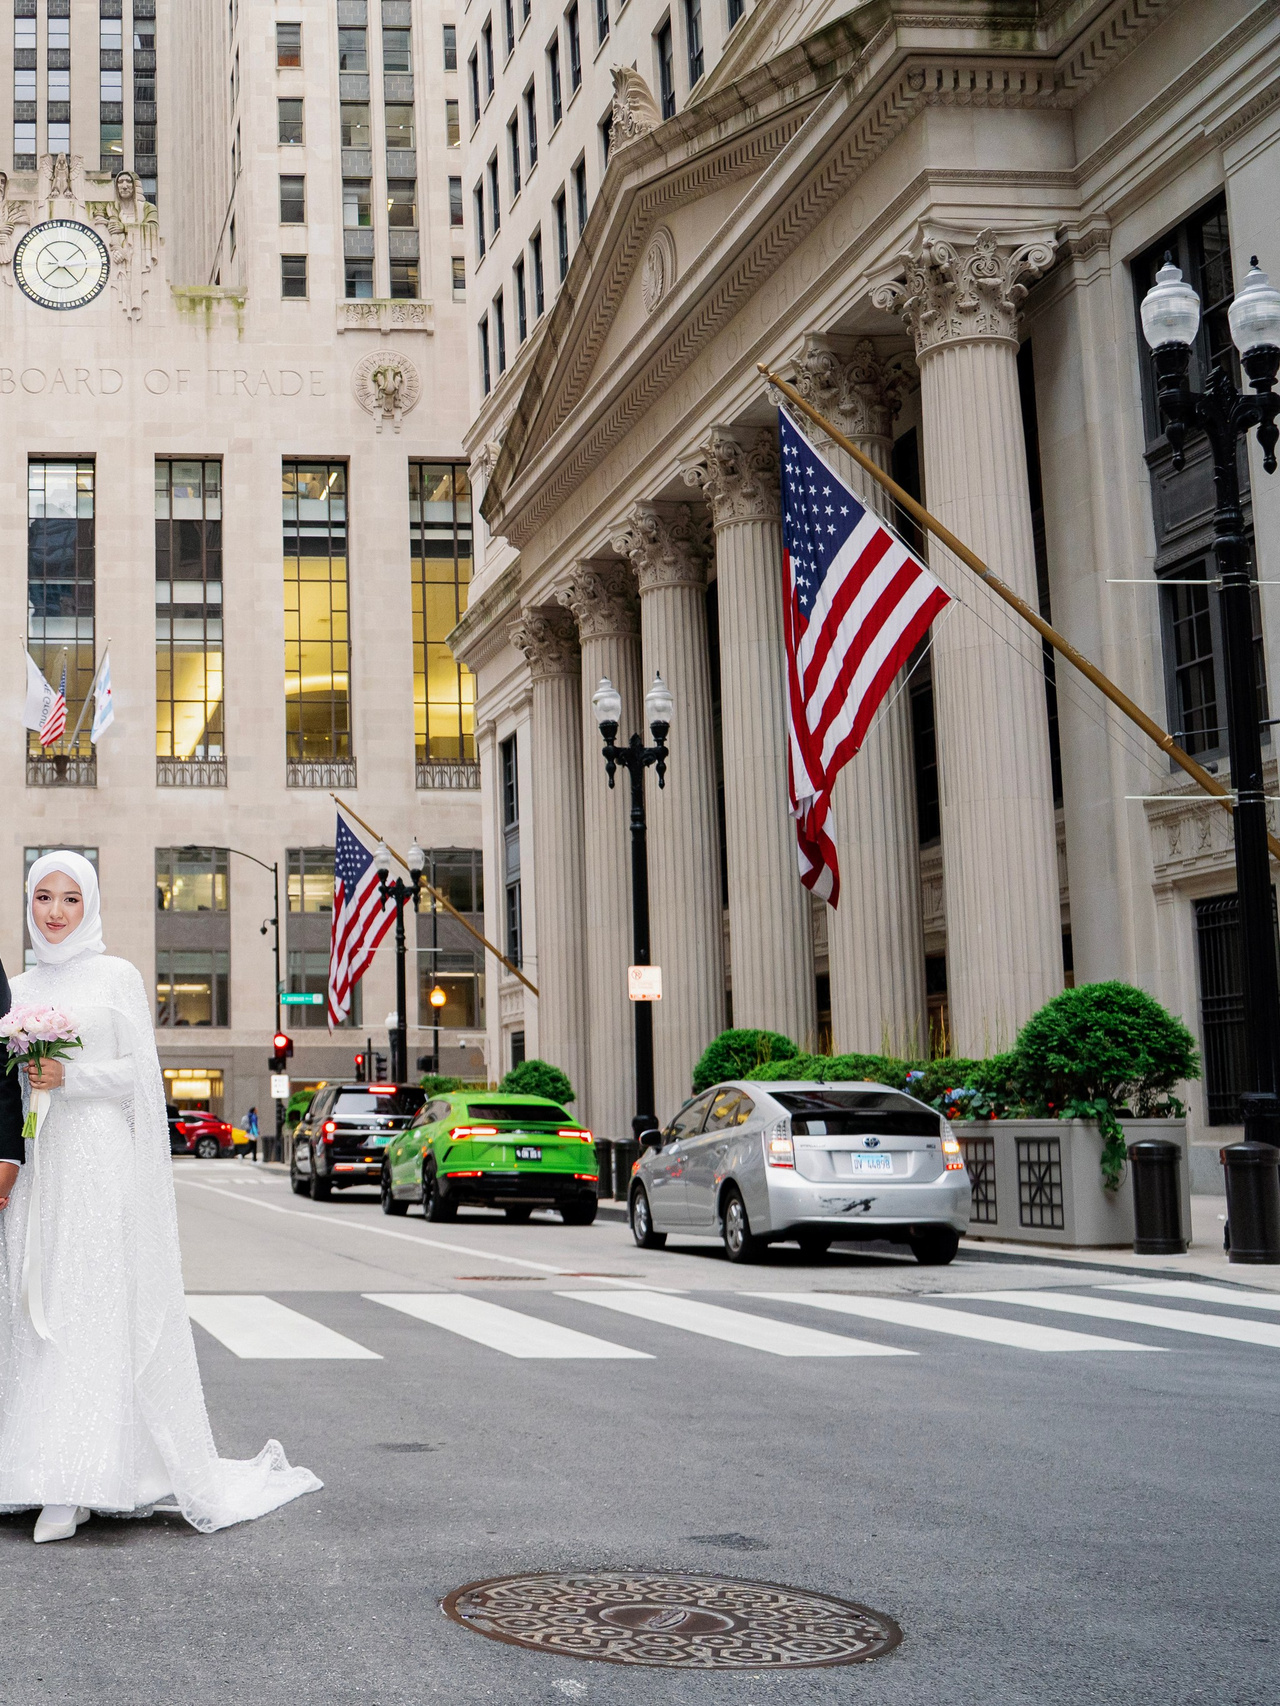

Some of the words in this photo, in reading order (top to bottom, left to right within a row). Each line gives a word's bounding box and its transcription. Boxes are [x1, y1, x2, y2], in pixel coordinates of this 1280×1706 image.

[673, 356, 715, 420] BANK
[726, 324, 747, 362] OF
[760, 196, 865, 325] CHICAGO
[143, 368, 191, 396] OF
[208, 369, 326, 398] TRADE
